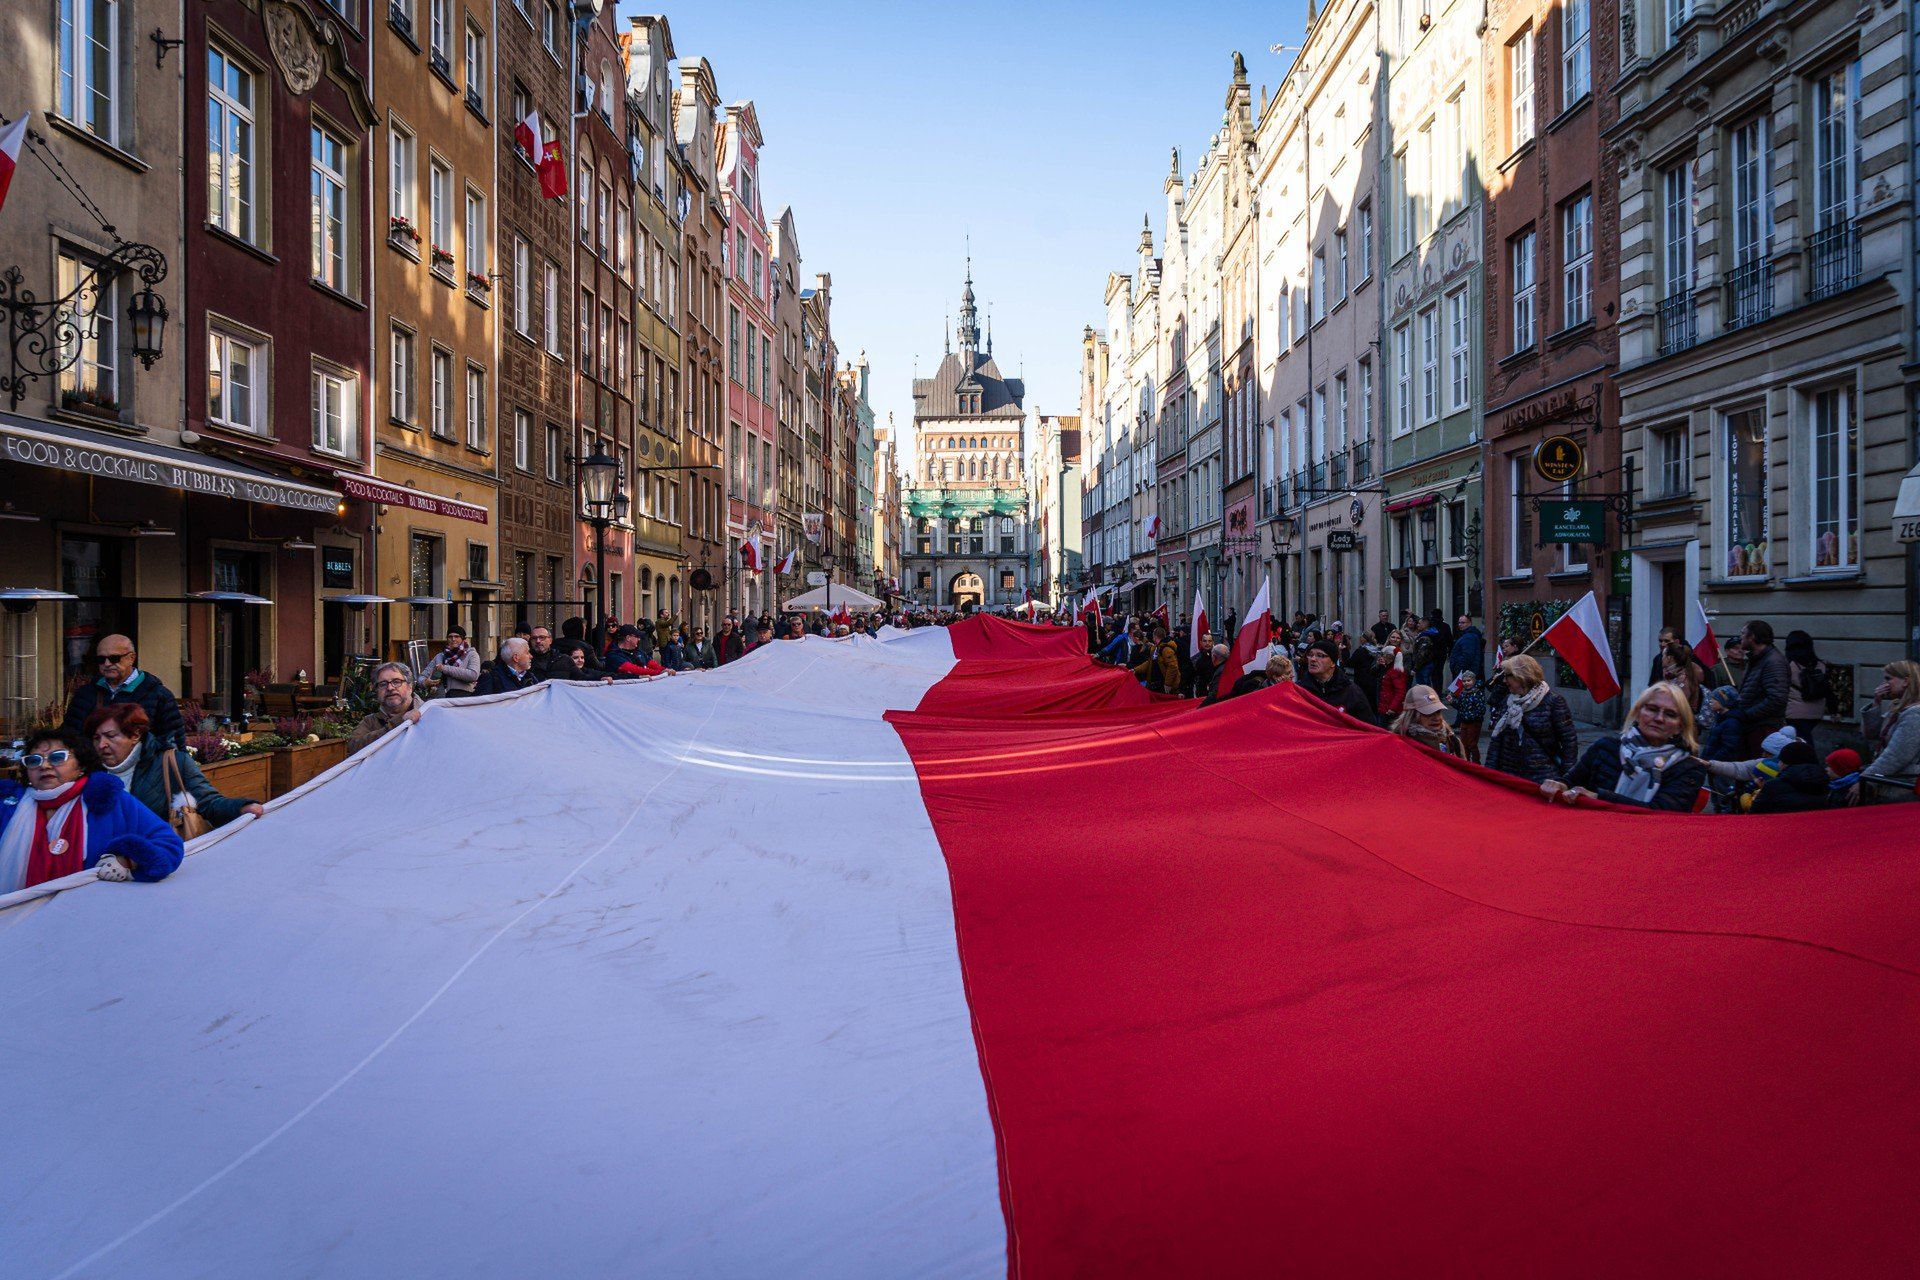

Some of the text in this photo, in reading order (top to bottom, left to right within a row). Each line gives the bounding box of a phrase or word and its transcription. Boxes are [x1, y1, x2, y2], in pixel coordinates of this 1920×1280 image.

[6, 437, 336, 512] FOOD & COCKTAILS BUBBLES FOOD & COCKTAILS
[345, 481, 367, 497] FOOD
[372, 488, 404, 505] COCKTAILS
[408, 496, 437, 512] BUBBLES
[442, 503, 457, 516] FOOD
[461, 507, 485, 522] COCKTAILS
[1333, 534, 1351, 544] Lody
[326, 561, 352, 571] BUBBLES
